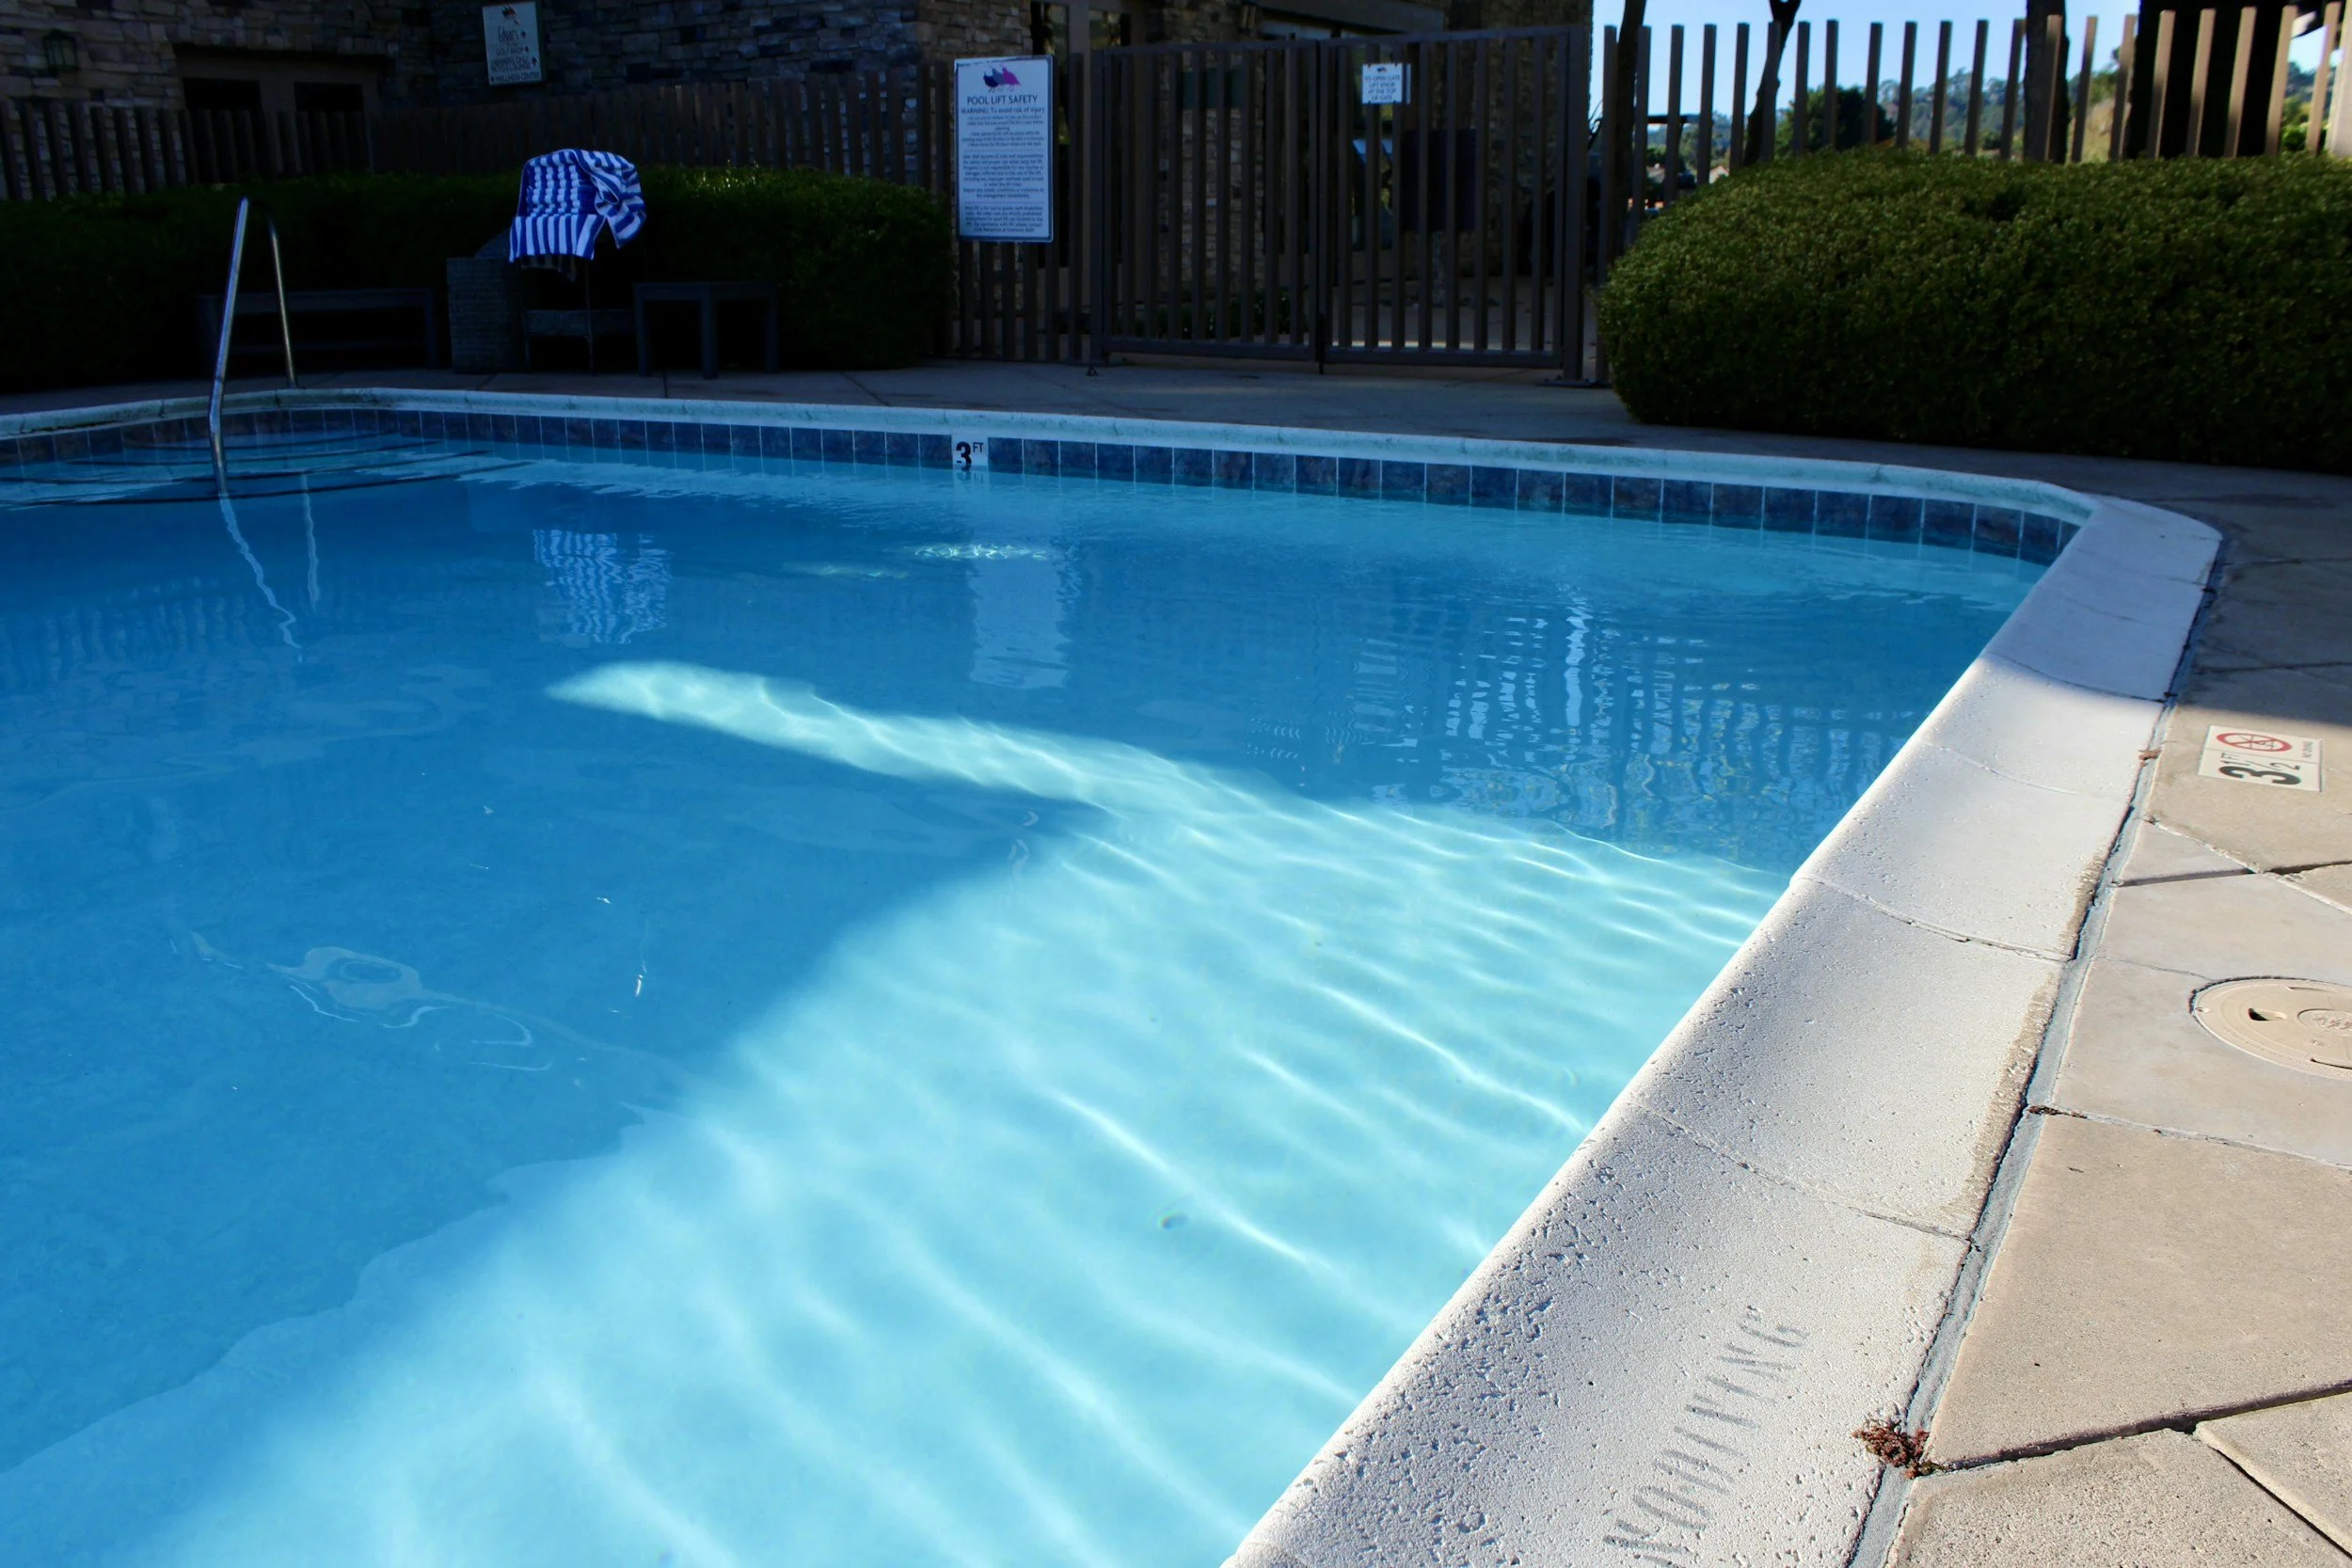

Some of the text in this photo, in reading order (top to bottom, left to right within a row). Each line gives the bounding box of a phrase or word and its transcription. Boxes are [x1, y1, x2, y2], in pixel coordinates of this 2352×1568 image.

[967, 95, 1038, 105] POOL LIFT SAFETY
[956, 441, 984, 472] 3 FT
[2218, 766, 2301, 785] 3
[1654, 1304, 1809, 1496] DIVING
